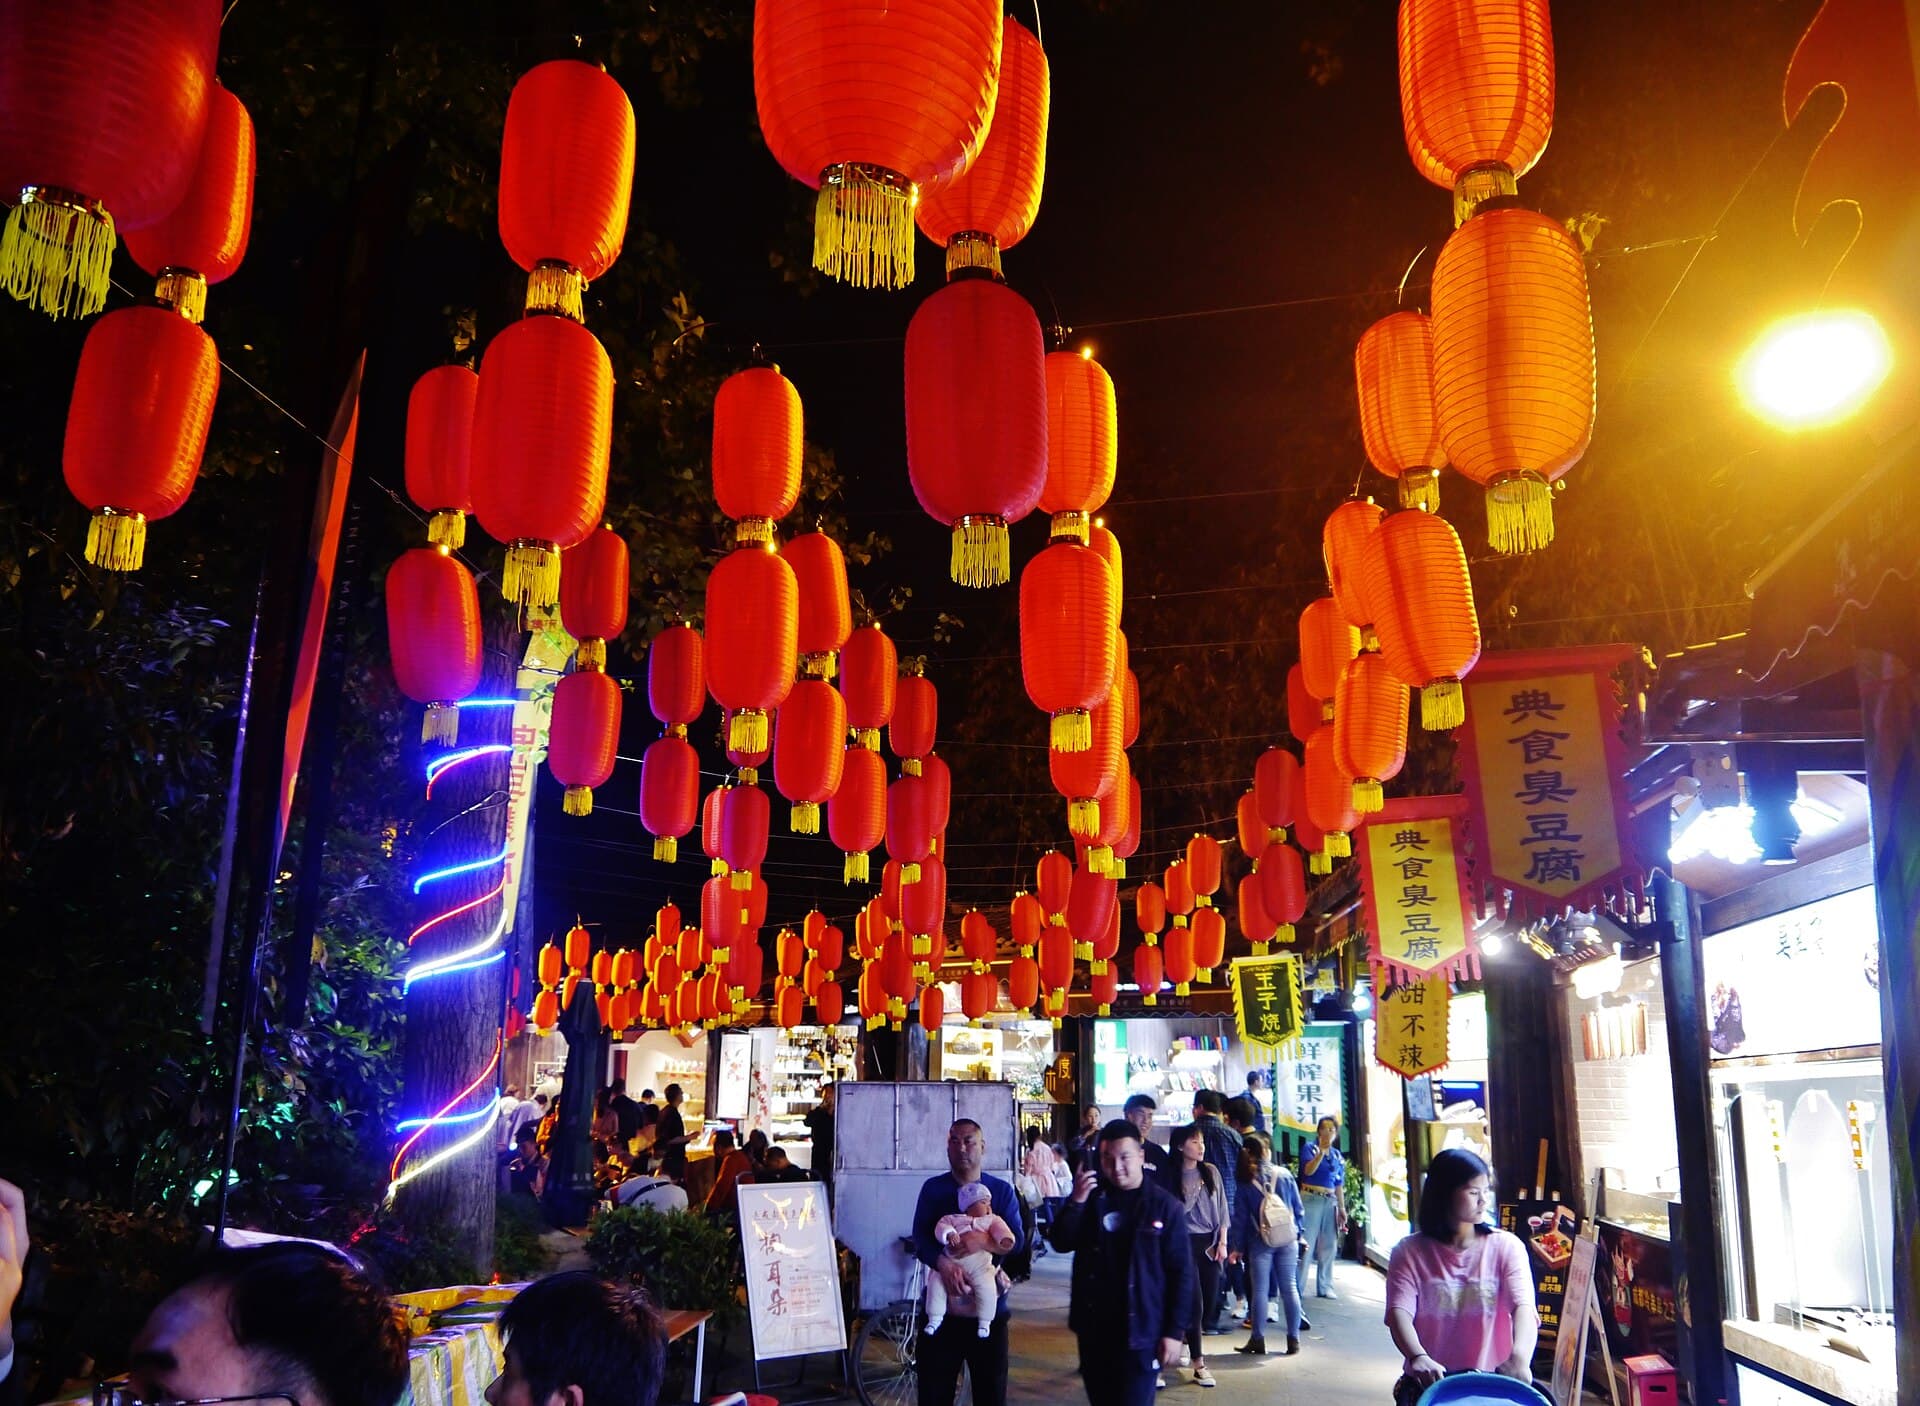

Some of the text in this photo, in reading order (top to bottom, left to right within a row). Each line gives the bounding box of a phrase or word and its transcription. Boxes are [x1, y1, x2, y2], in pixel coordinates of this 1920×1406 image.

[1502, 688, 1585, 885] 典食臭豆腐
[1389, 829, 1443, 961] 典食臭豆腐
[1255, 971, 1281, 1032] 玉子烧
[1398, 981, 1426, 1069] 甜不辣
[1294, 1041, 1325, 1125] 鲜榨果汁
